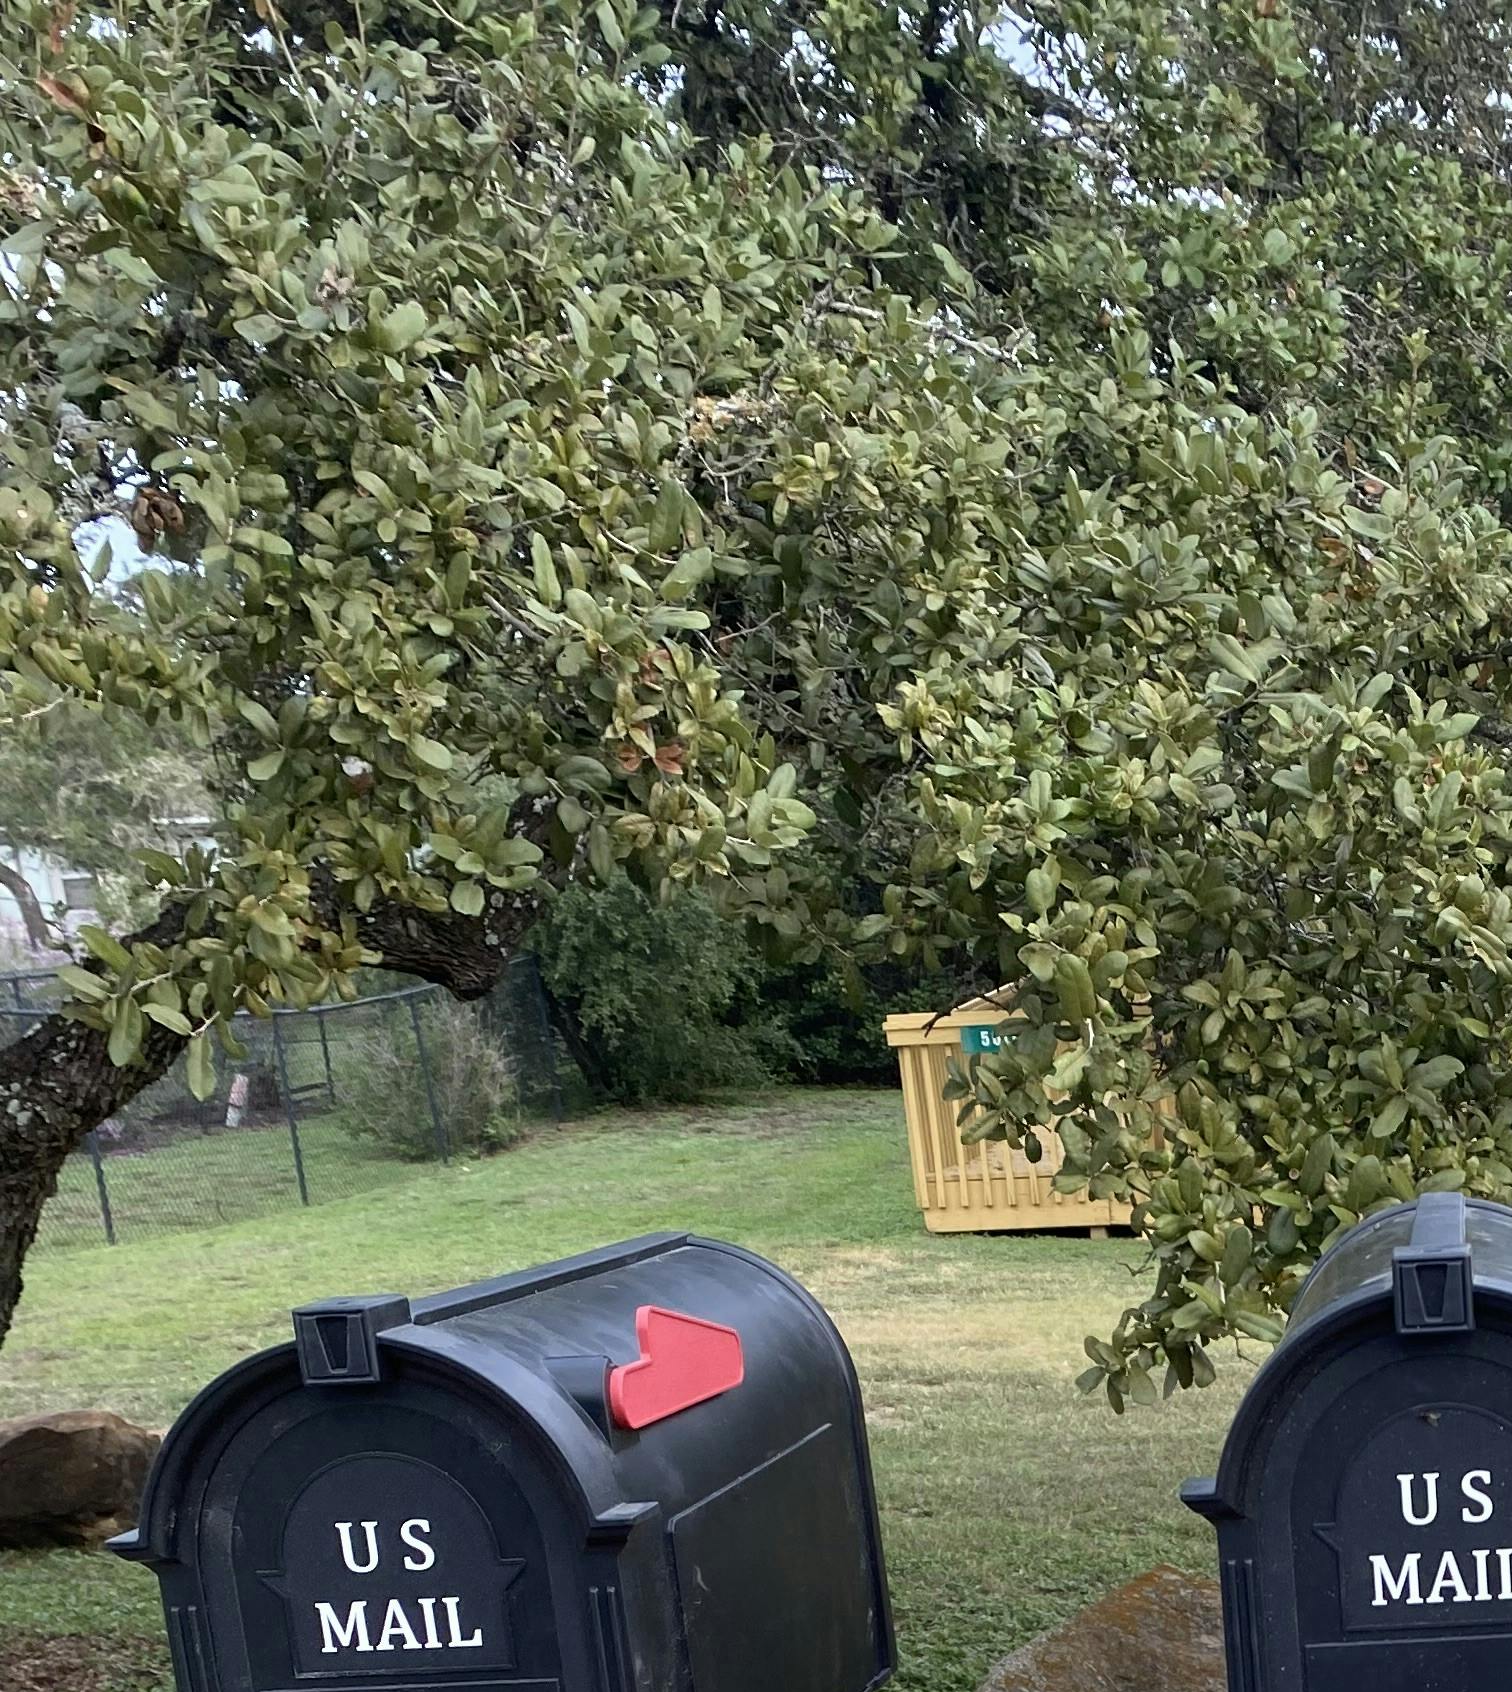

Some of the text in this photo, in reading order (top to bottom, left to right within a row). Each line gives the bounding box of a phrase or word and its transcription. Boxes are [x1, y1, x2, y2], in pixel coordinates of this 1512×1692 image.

[1396, 1469, 1494, 1525] U S
[334, 1519, 435, 1573] U S
[314, 1597, 483, 1653] MAIL
